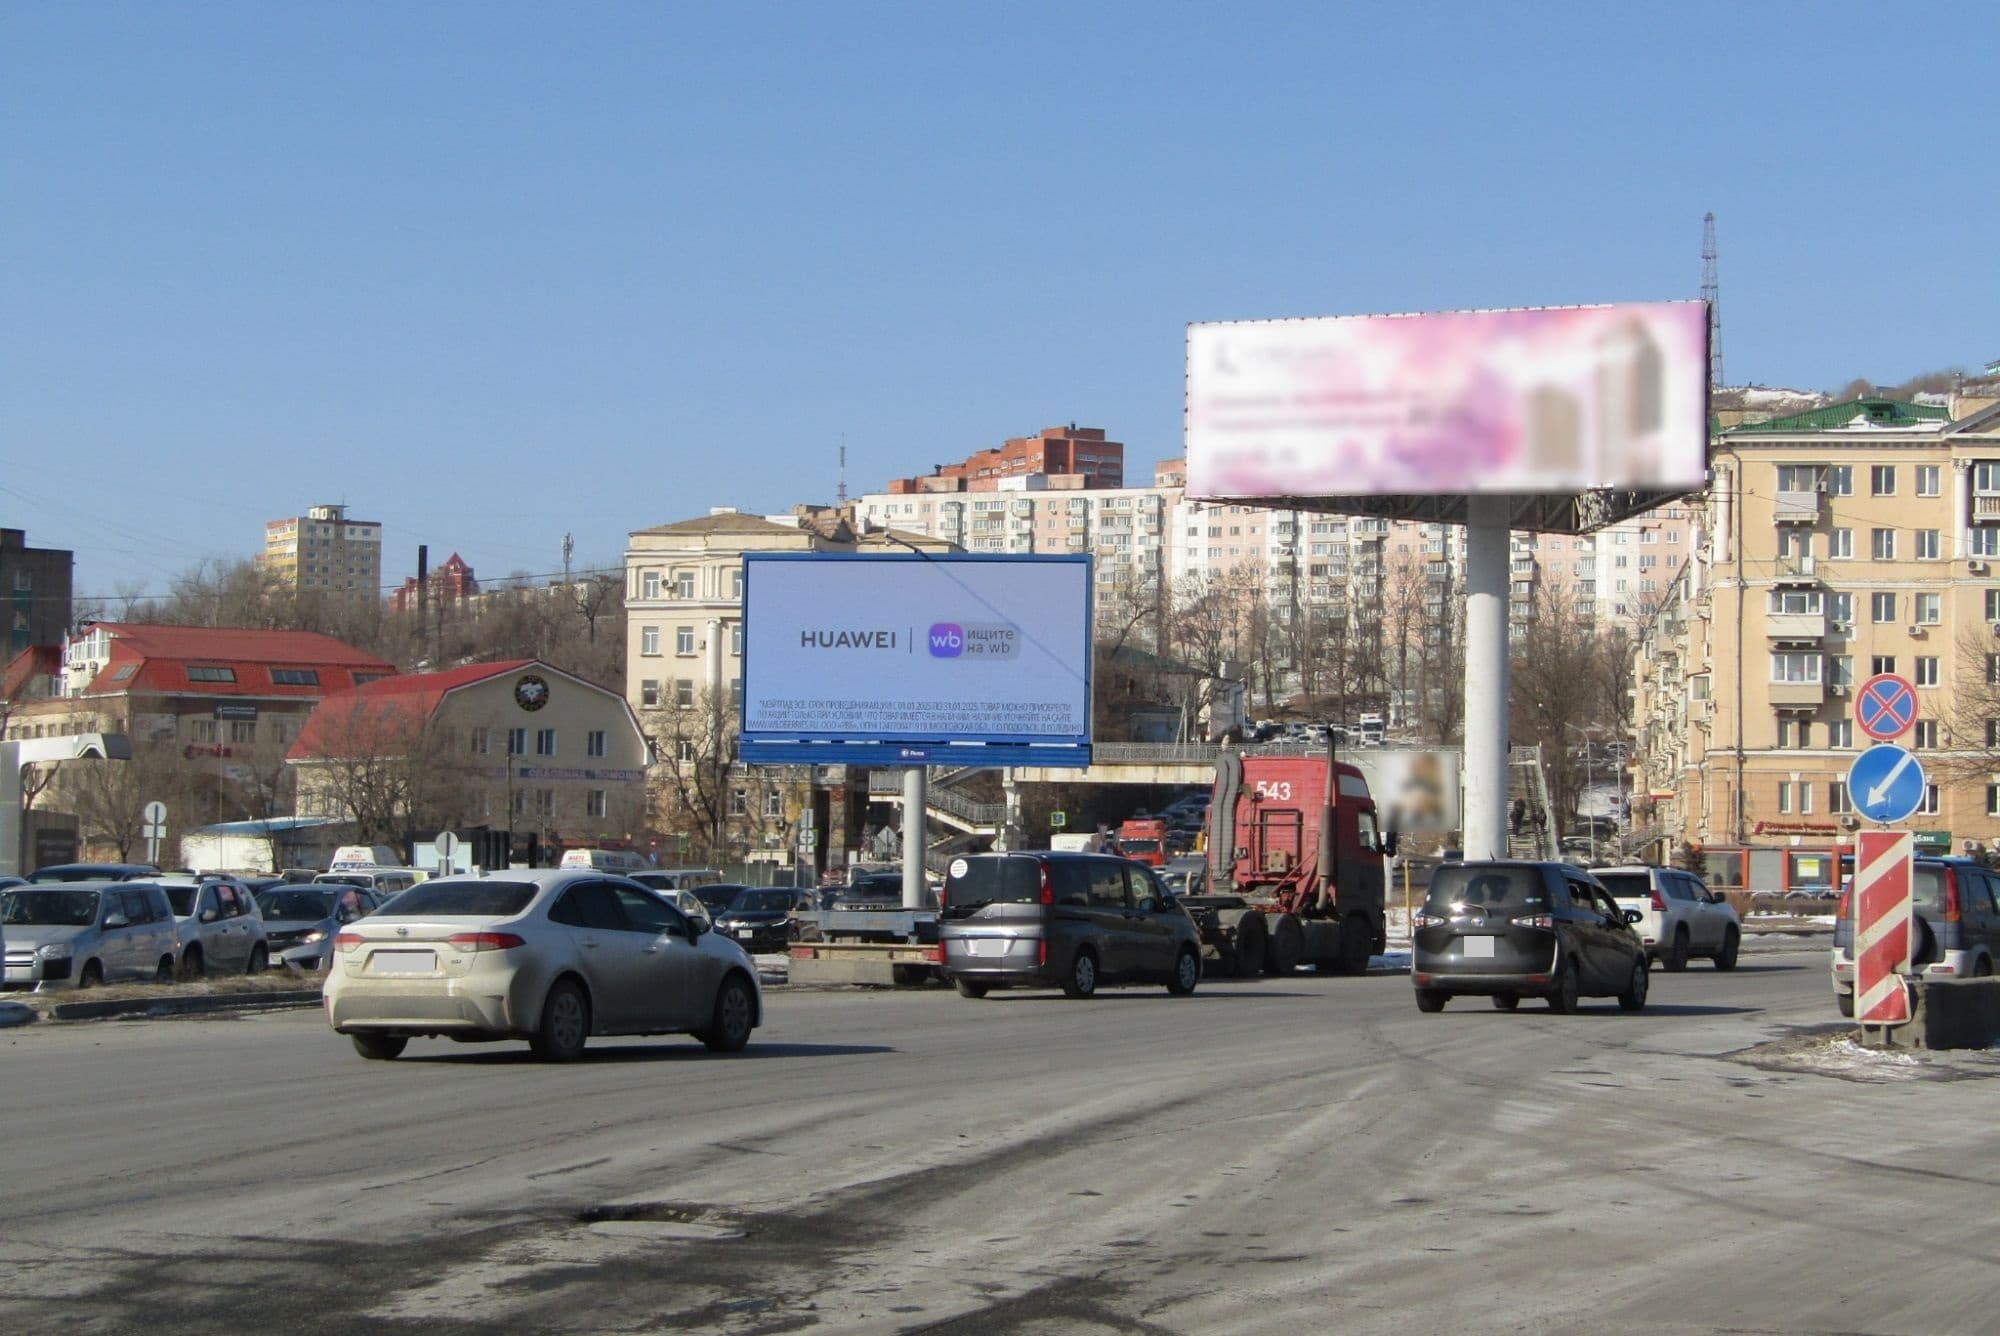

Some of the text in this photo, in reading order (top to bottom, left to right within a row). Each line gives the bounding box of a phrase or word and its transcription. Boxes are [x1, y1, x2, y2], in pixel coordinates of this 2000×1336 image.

[801, 631, 897, 648] HUAWEI
[932, 631, 961, 648] wb
[967, 630, 1014, 642] ищите
[967, 642, 1011, 653] на wb
[1256, 781, 1291, 800] 543
